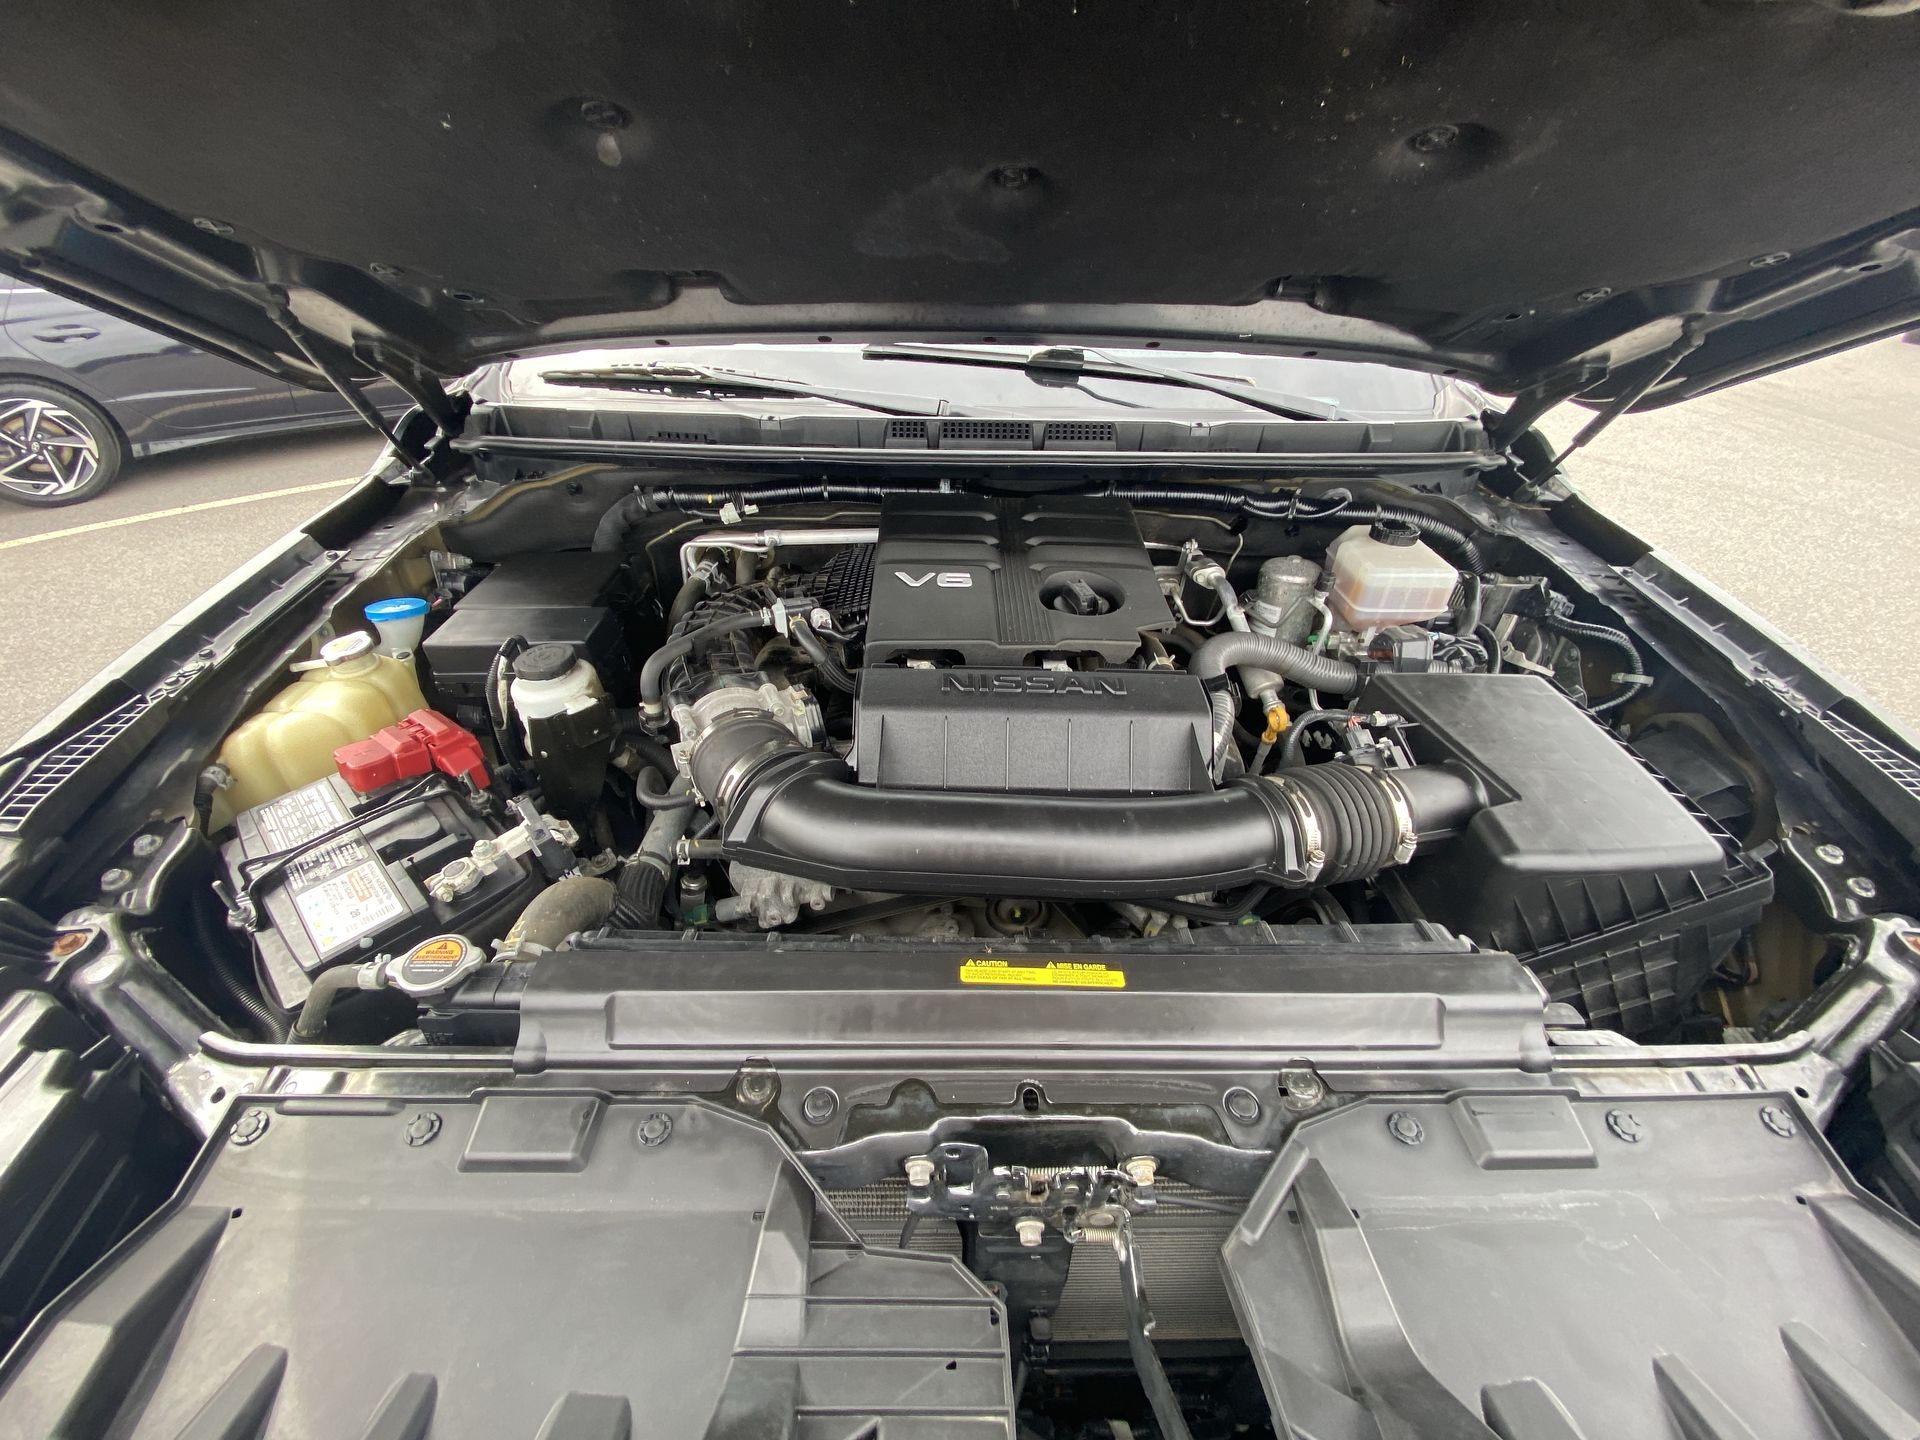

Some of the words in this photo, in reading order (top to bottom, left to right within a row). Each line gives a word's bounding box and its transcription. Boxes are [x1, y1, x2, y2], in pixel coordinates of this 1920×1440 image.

[894, 572, 973, 588] V6
[941, 673, 1127, 695] NISSAN
[1056, 962, 1073, 970] MISE
[1083, 963, 1107, 971] GARDE
